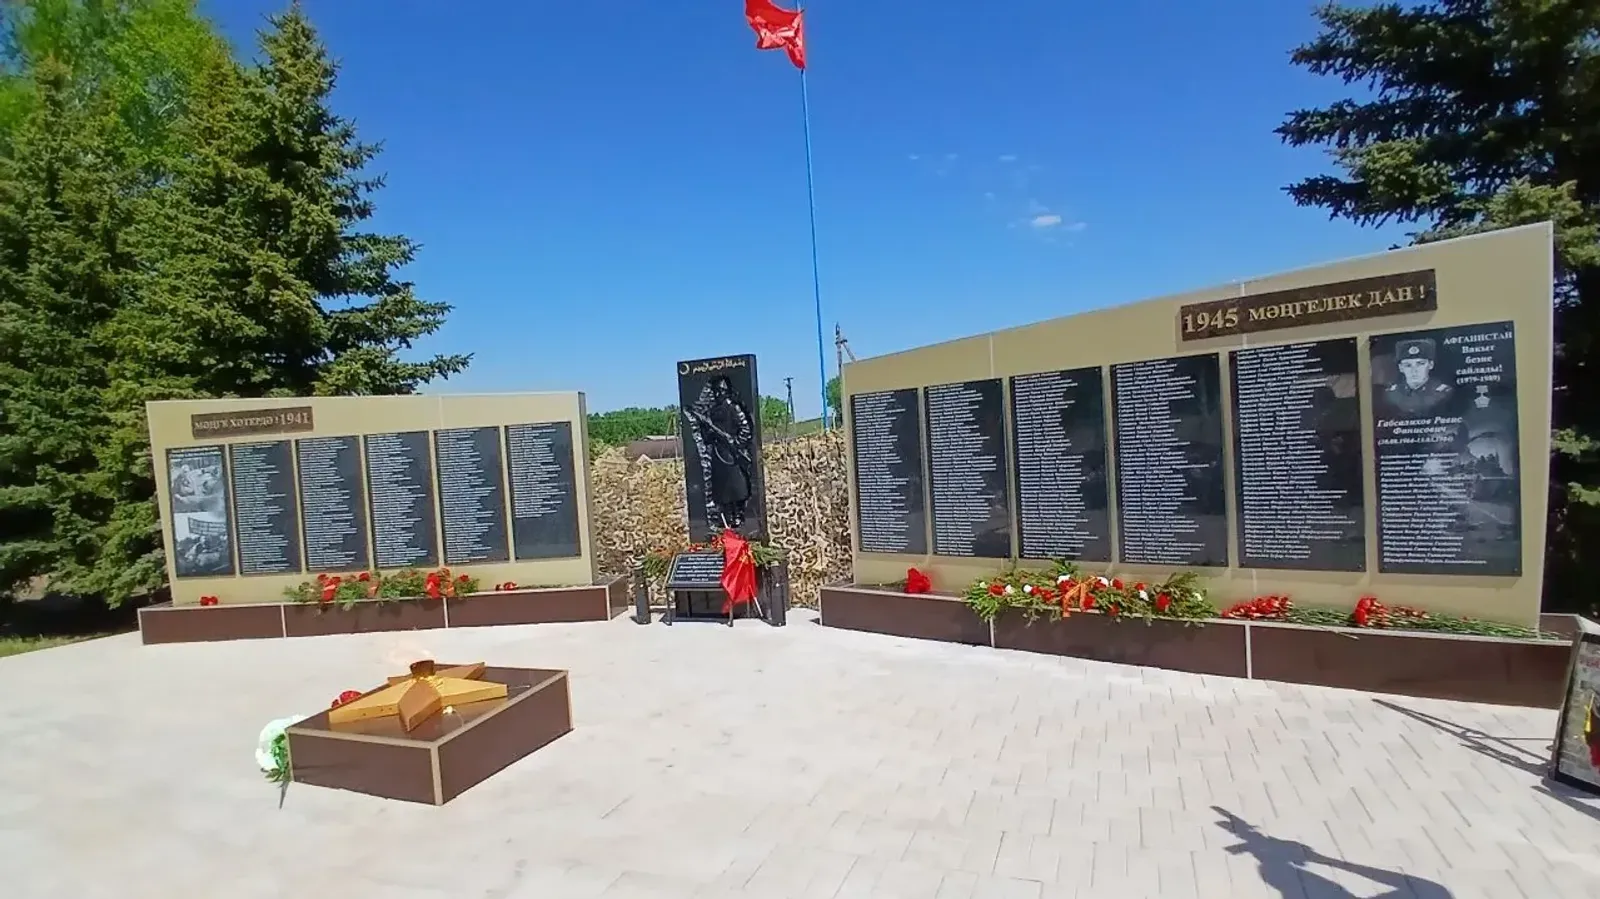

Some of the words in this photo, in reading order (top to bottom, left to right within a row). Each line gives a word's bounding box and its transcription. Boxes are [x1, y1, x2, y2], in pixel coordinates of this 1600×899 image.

[1184, 308, 1239, 333] 1945
[1248, 293, 1363, 322] МӘҢГЕЛЕК
[1367, 286, 1413, 308] ДАН
[1443, 331, 1513, 345] АФГАНИСТАН
[1462, 344, 1496, 354] Вакыт
[1465, 355, 1493, 364] безне
[1456, 364, 1503, 375] сайлады!
[1456, 375, 1501, 385] (1979-1989)
[280, 412, 311, 425] 1941
